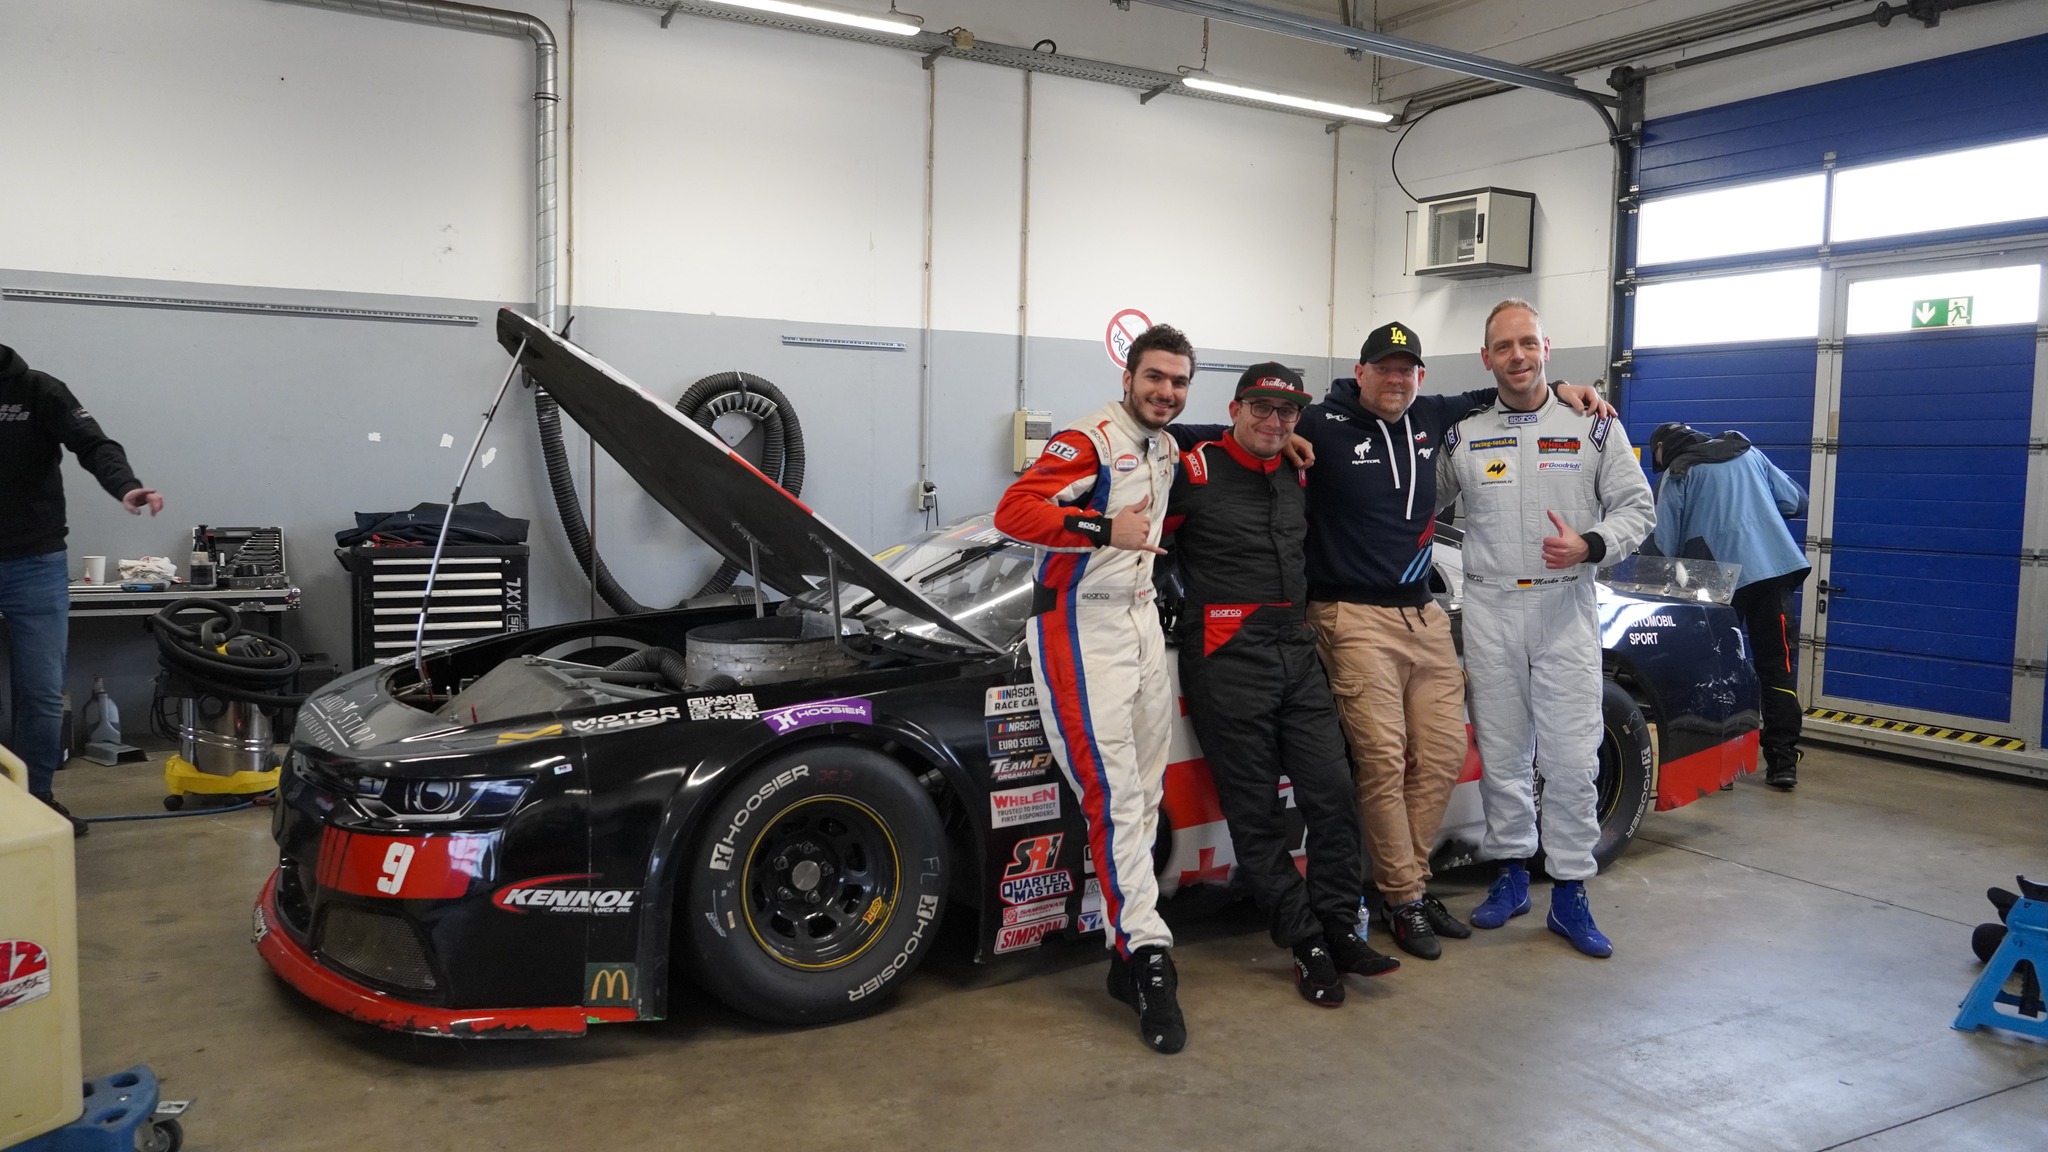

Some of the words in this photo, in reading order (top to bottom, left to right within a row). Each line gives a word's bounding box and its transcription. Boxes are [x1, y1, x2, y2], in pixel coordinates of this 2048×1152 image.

[1391, 327, 1407, 345] LA
[1509, 415, 1537, 424] sparco
[1471, 439, 1516, 448] racing-total.de
[1538, 441, 1580, 449] WHELEN
[1539, 462, 1581, 470] BFGoodrich
[506, 577, 521, 611] XXL
[1082, 592, 1110, 600] sparco
[1210, 609, 1242, 618] sparco
[1630, 615, 1677, 627] UTOMOBIL
[1629, 632, 1658, 645] SPORT
[1005, 687, 1037, 700] NASCA
[796, 706, 866, 719] HOOSIER
[994, 700, 1019, 711] RACE
[572, 706, 679, 727] MOTOR
[573, 712, 681, 731] VISION
[337, 711, 376, 745] STIPP
[1008, 720, 1040, 732] NASCAR
[998, 739, 1019, 750] EURO
[1020, 736, 1044, 748] SERIES
[997, 769, 1046, 780] ORGANIZATION
[722, 764, 810, 845] HOOSIER
[993, 787, 1056, 809] WHELEN
[1626, 766, 1650, 839] HOOSIER
[997, 806, 1023, 816] TRUSTED
[1023, 805, 1031, 813] TO
[1032, 802, 1056, 811] PROTECT
[1001, 815, 1017, 823] FIRST
[377, 842, 415, 895] 9
[1002, 871, 1067, 898] QUARTER
[503, 888, 635, 906] KENNOL
[1014, 881, 1070, 903] MASTER
[1001, 920, 1062, 949] SIMPSON
[848, 918, 929, 1001] HOOSIER
